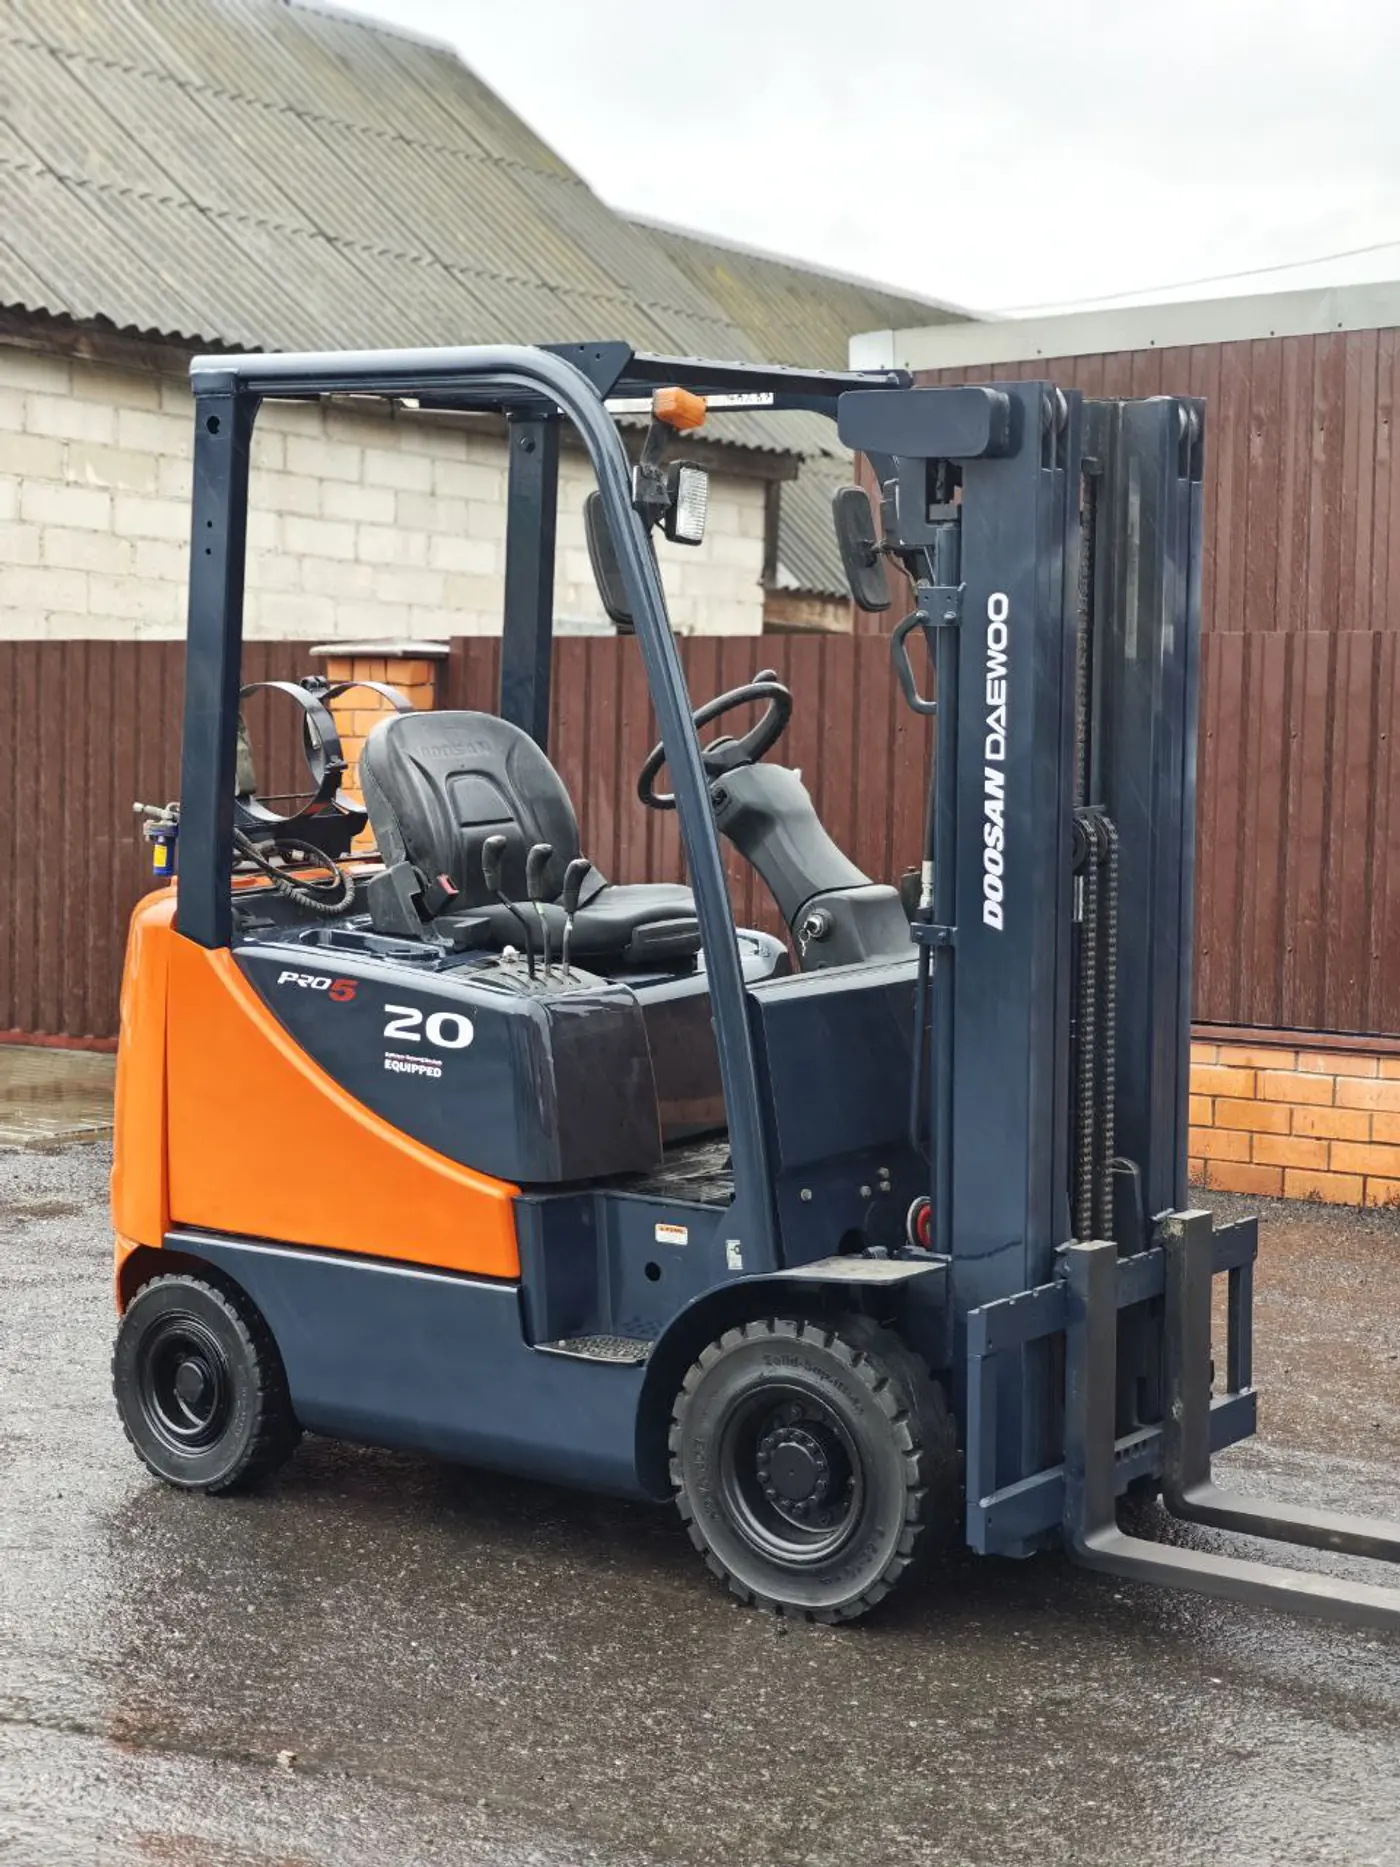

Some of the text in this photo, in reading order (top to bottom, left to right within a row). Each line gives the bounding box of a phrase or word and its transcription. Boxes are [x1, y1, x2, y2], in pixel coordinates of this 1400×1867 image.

[982, 592, 1010, 931] DOOSAN DAEWOO
[383, 1004, 475, 1049] 20
[384, 1058, 442, 1078] EQUIPPED
